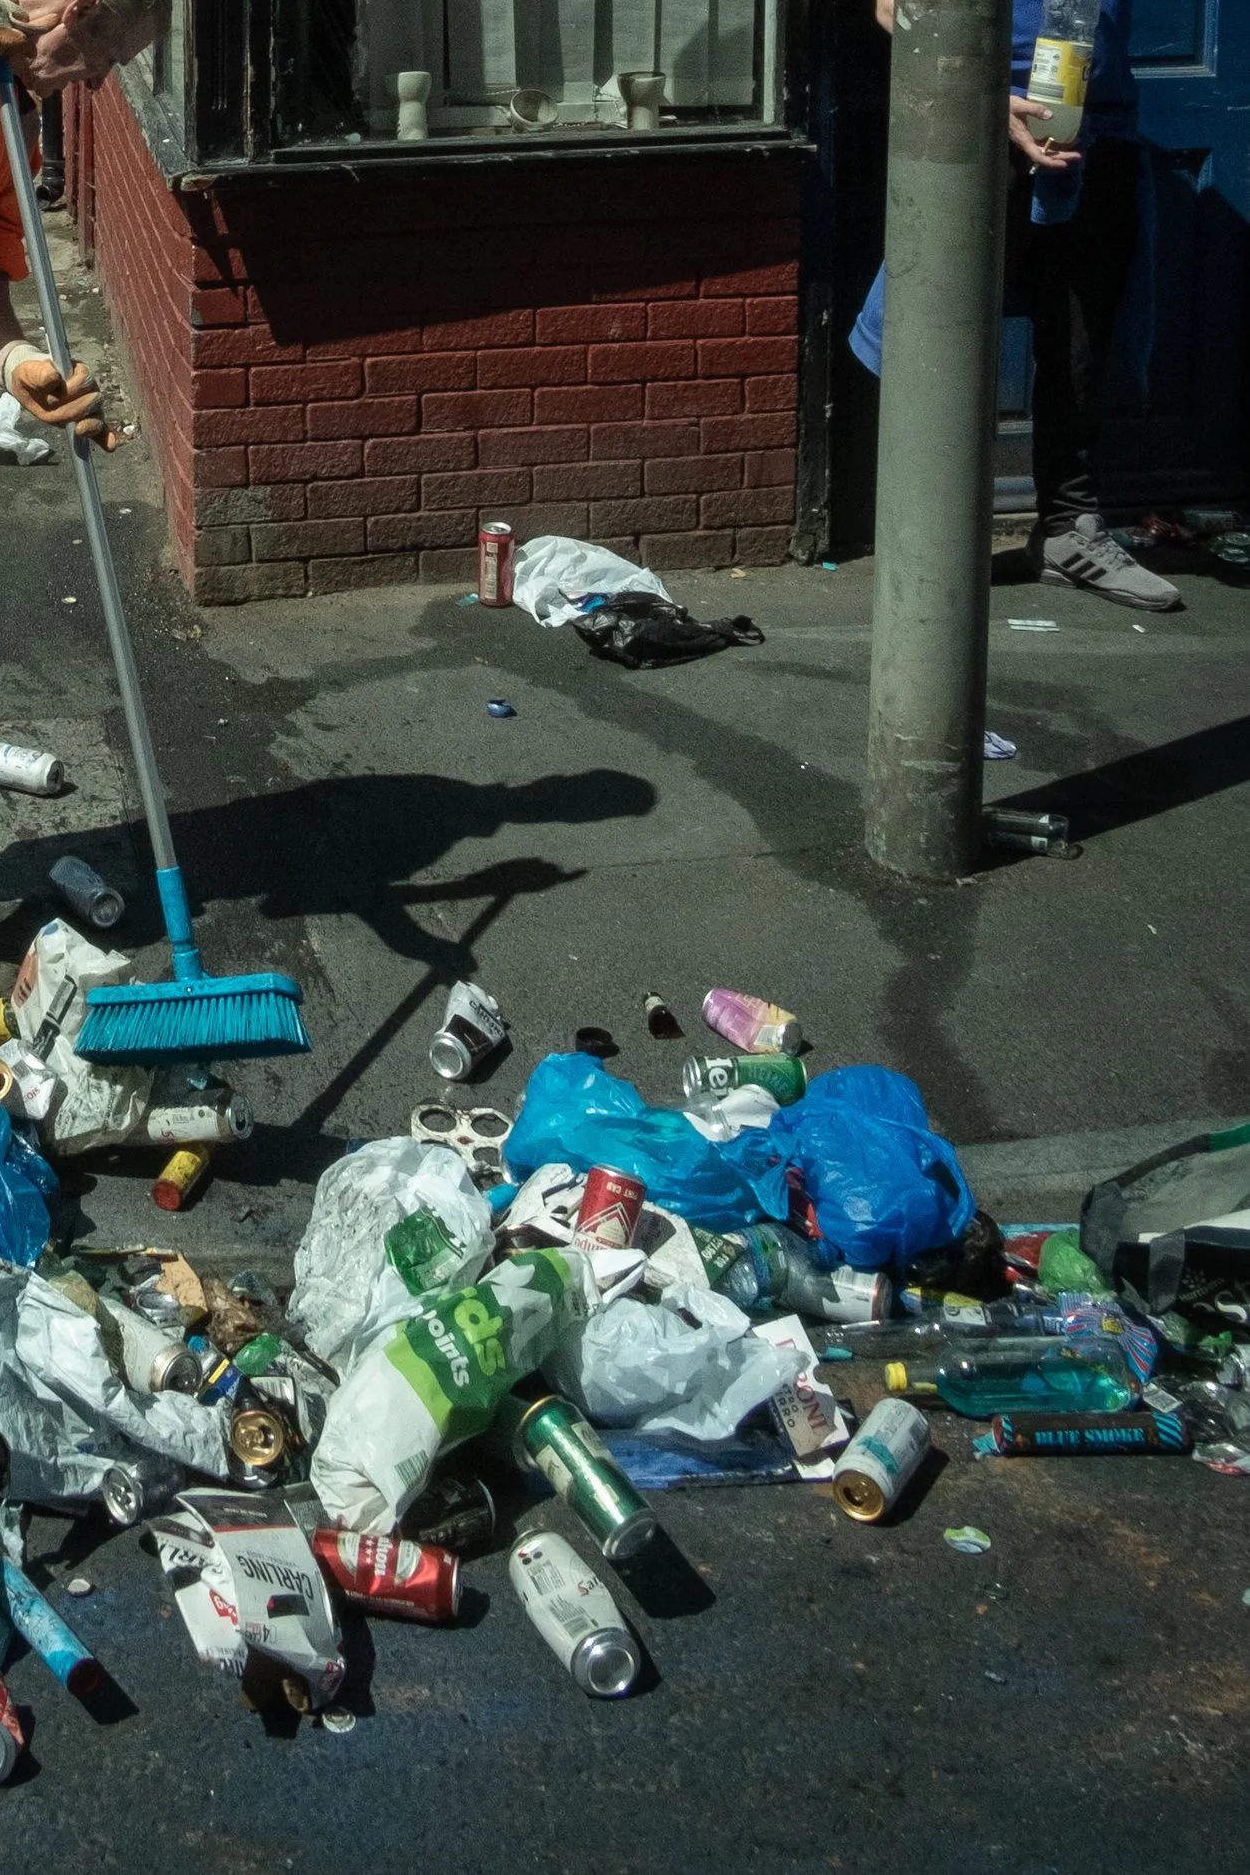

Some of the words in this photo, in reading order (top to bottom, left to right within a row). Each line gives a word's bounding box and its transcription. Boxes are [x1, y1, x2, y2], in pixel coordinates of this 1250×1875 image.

[605, 1181, 623, 1195] CAN
[1034, 1428, 1080, 1445] BLUE
[1084, 1427, 1145, 1444] SMOKE
[372, 1535, 389, 1577] ahou
[235, 1553, 314, 1601] CARLING
